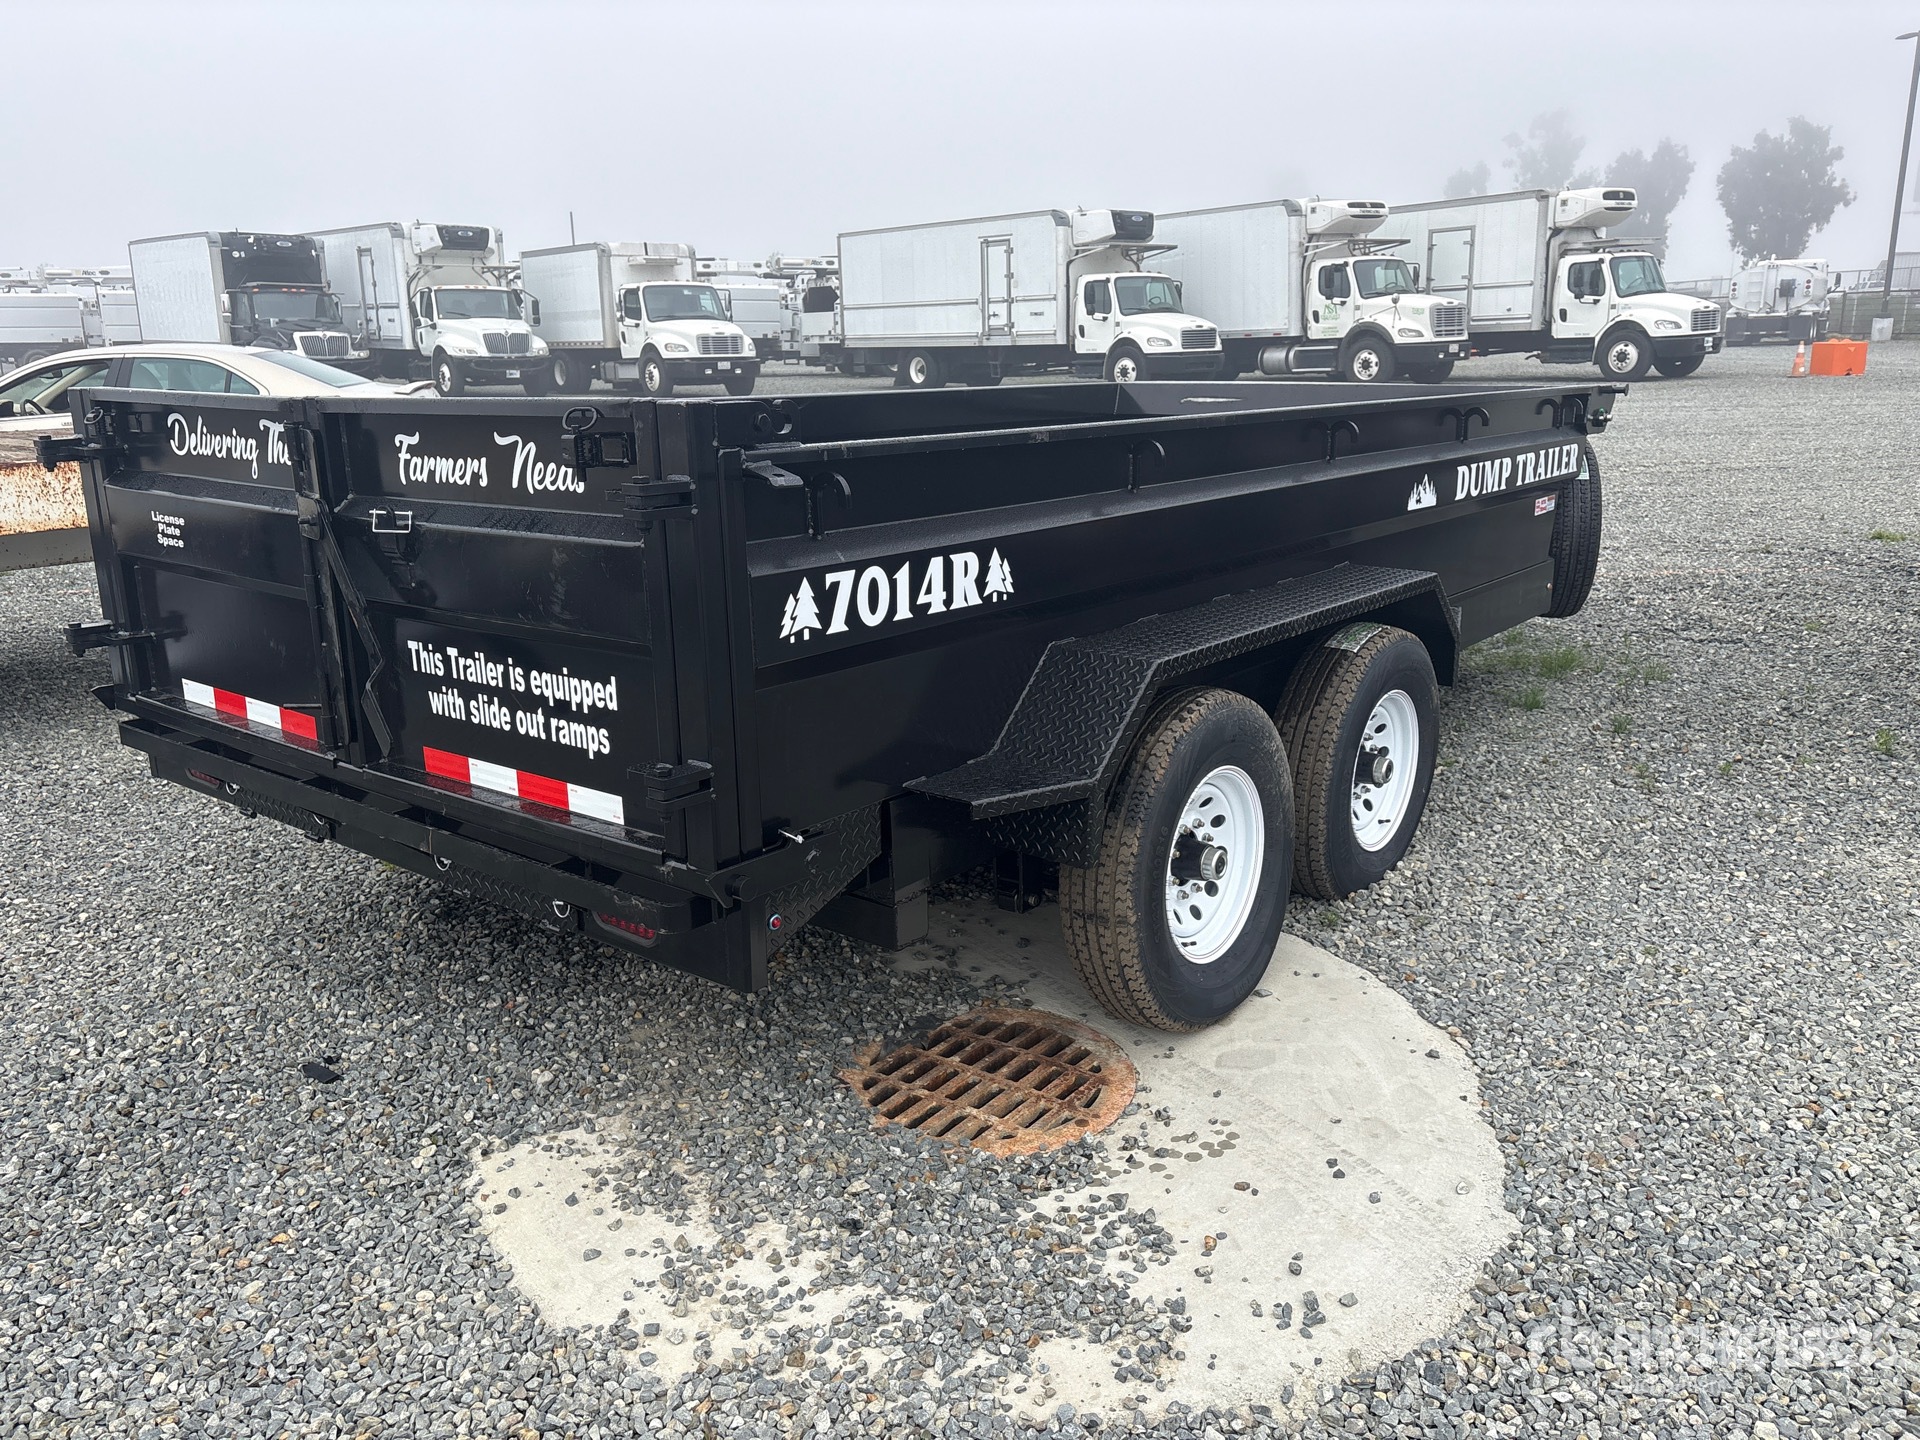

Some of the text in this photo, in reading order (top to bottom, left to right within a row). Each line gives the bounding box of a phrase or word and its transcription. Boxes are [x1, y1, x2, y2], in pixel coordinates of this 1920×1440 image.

[167, 412, 259, 480] Delivering
[394, 431, 488, 488] Farmers
[1454, 443, 1579, 502] DUMP TRAILER
[151, 510, 185, 526] License
[157, 523, 181, 537] Plate
[157, 534, 184, 548] Space
[825, 551, 983, 635] 7014R
[407, 640, 618, 714] This Trailer is equipped
[428, 686, 611, 760] with slide out ramps
